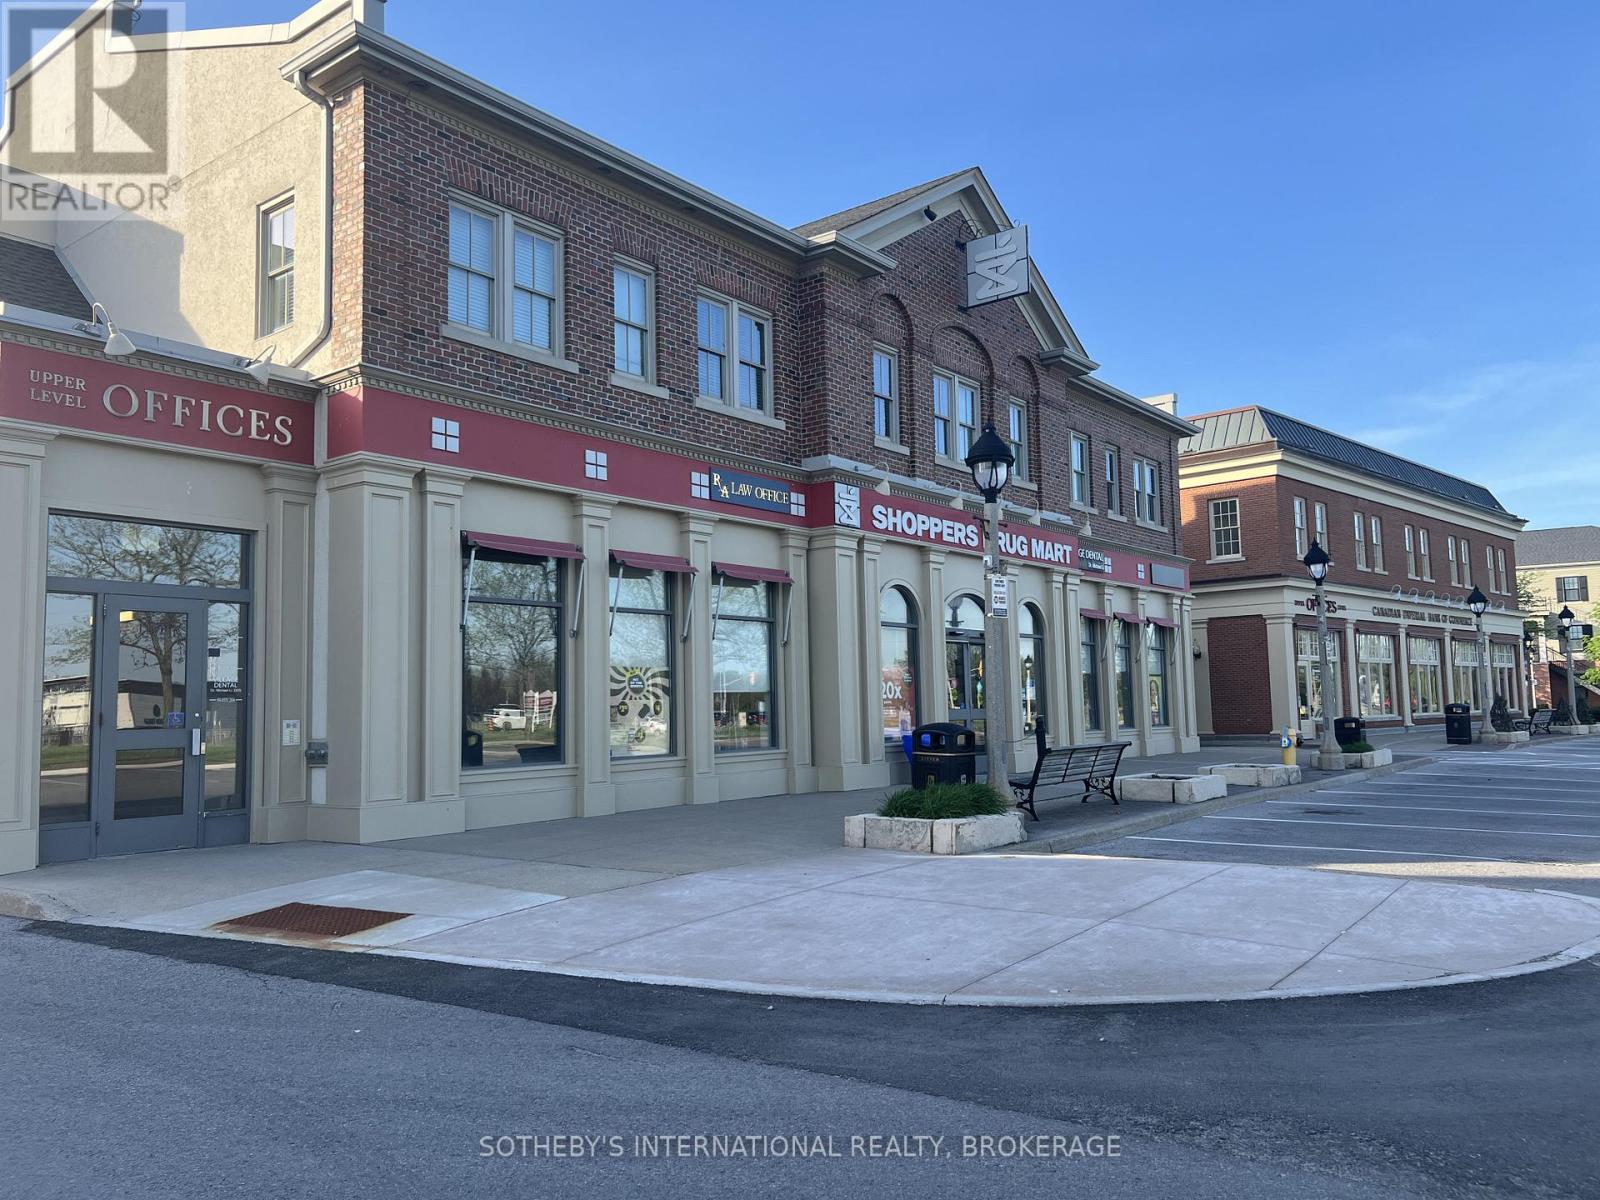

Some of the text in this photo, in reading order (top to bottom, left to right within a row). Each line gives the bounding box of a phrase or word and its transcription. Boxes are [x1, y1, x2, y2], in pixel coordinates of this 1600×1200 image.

[29, 368, 87, 392] UPPER
[30, 387, 87, 410] LEVEL
[102, 383, 294, 447] OFFICES
[731, 481, 753, 497] LAW
[754, 486, 789, 504] OFFICE
[871, 504, 1072, 564] SHOPPERS RUG MART
[1085, 549, 1104, 562] DENTAL
[1372, 606, 1401, 619] CANADIAN
